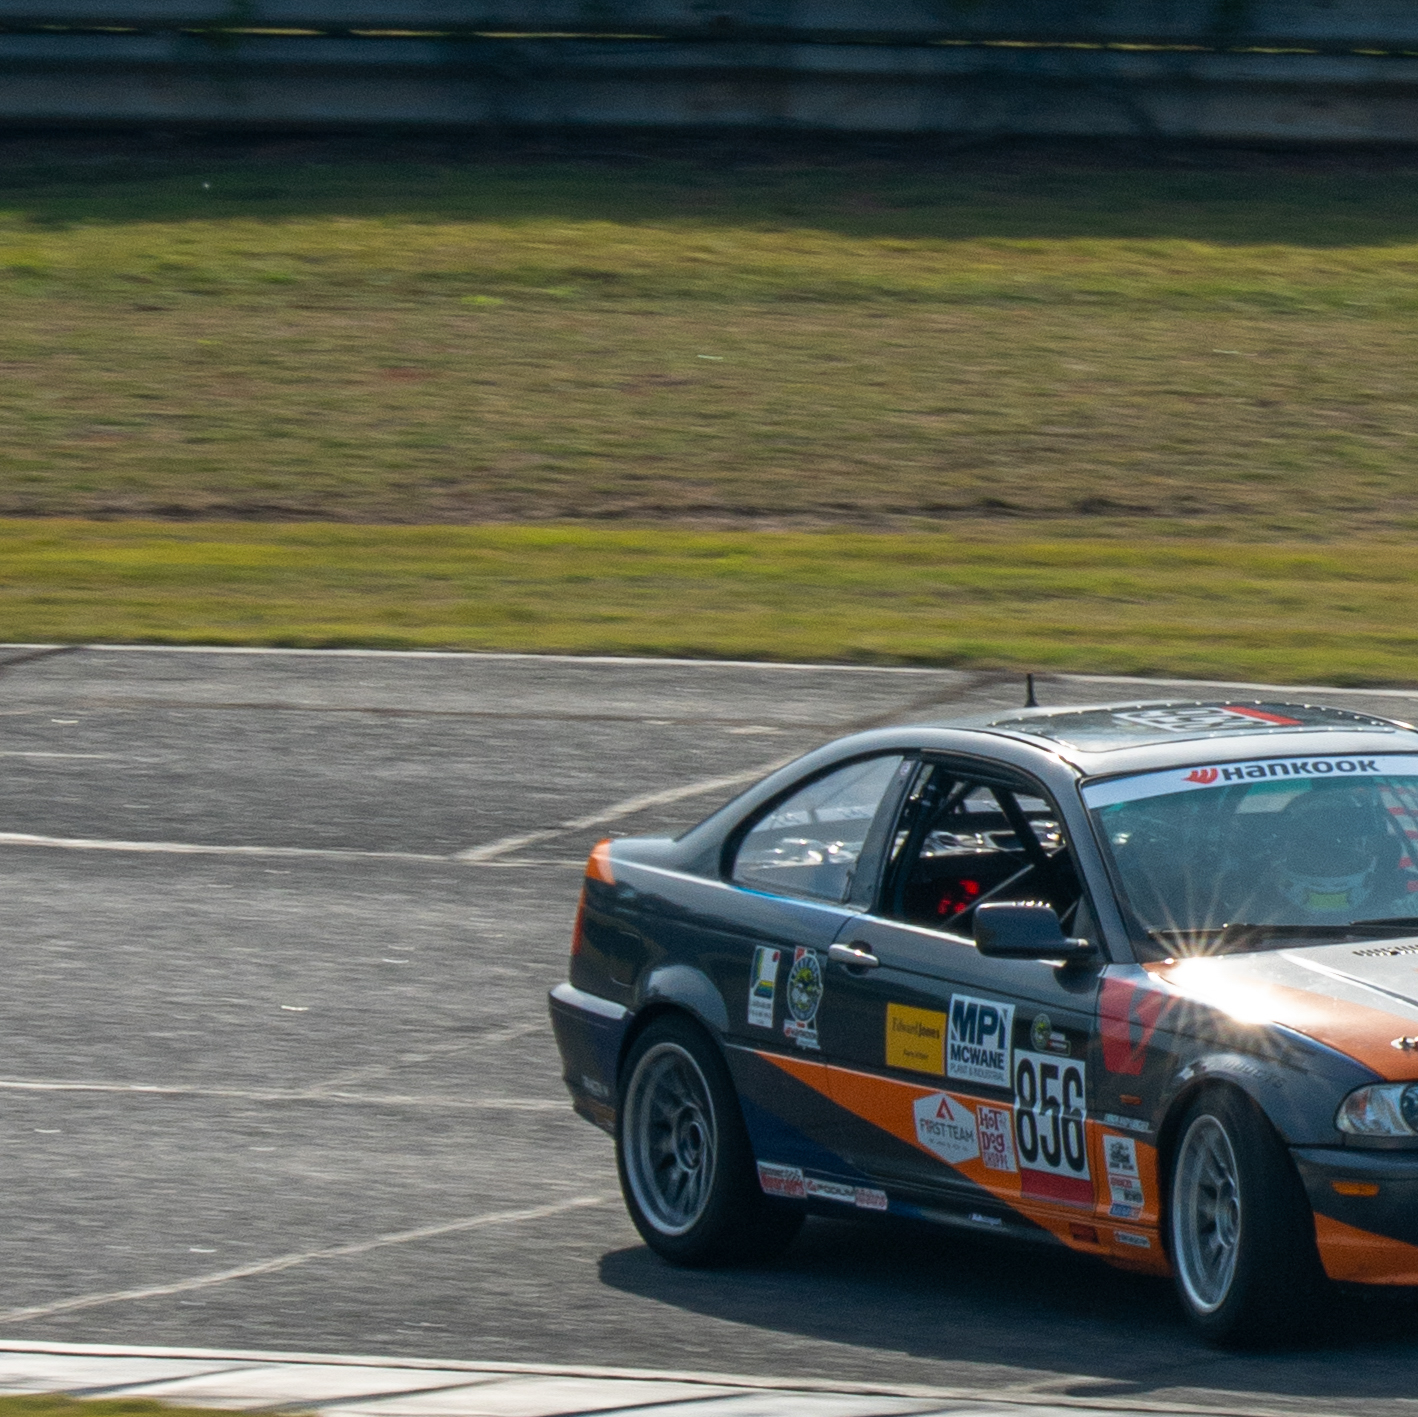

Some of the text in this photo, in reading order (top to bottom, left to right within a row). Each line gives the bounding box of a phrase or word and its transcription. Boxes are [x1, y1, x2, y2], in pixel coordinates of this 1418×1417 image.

[950, 1043, 1005, 1070] MCWANE
[1016, 1057, 1085, 1172] 856
[919, 1118, 974, 1142] FIRST TEAM
